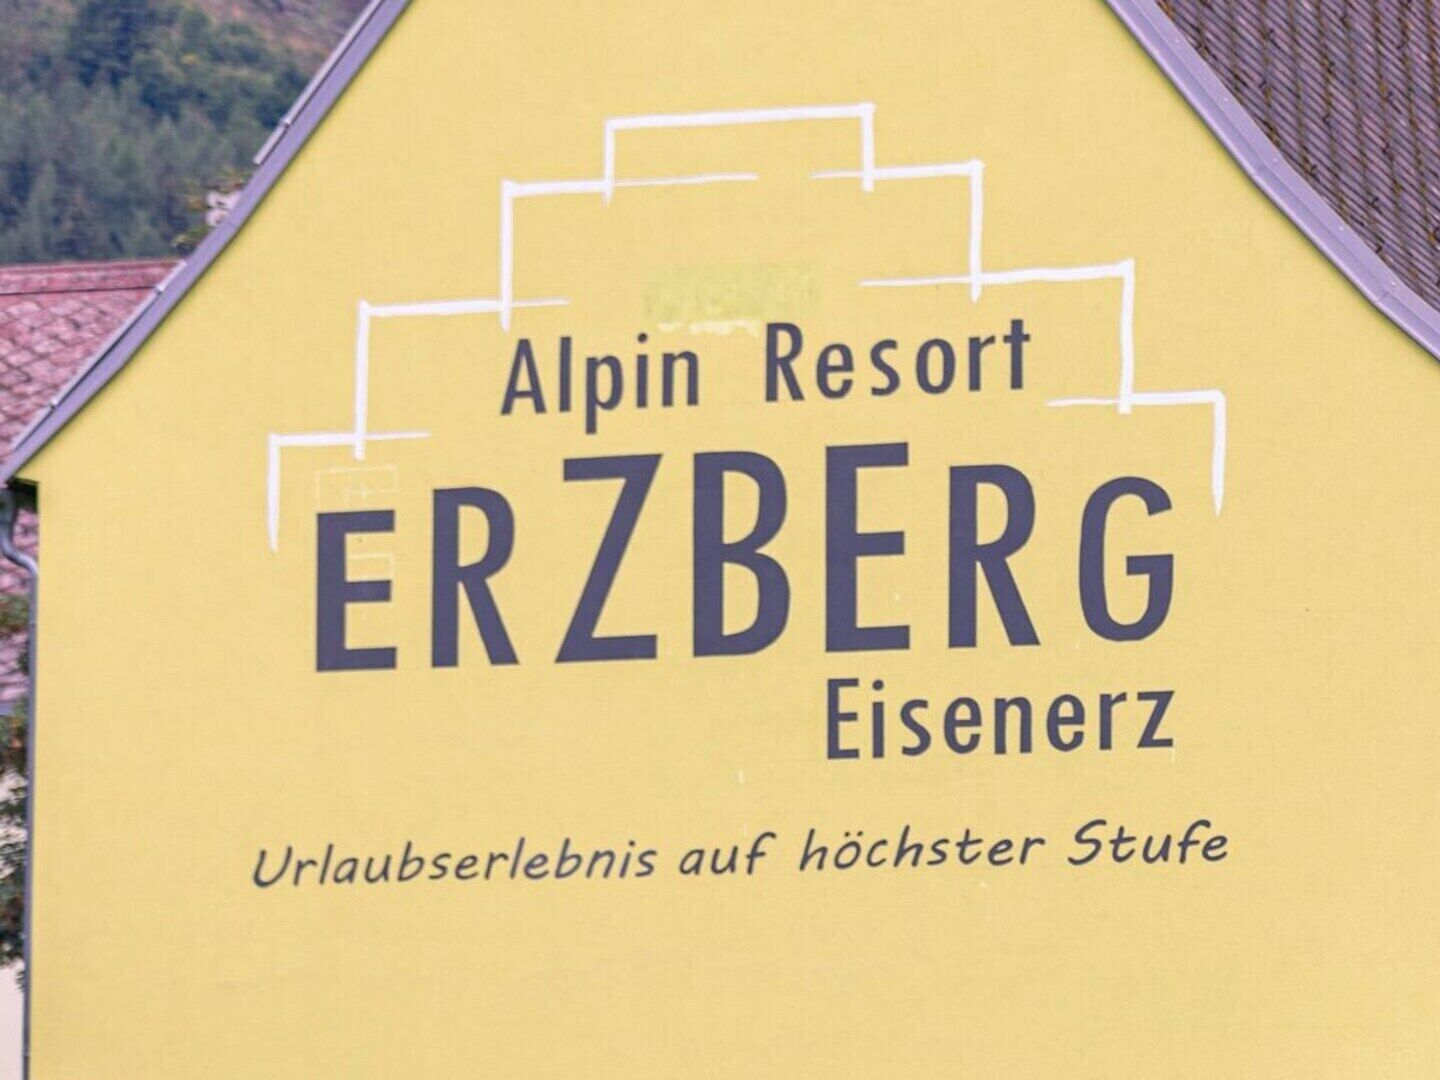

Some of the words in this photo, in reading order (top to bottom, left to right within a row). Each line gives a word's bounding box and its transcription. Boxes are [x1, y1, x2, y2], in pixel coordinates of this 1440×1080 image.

[500, 332, 699, 435] Alpin
[765, 318, 1031, 403] Resort
[315, 442, 1175, 673] ERZBERG
[826, 677, 1175, 761] Eisenerz
[252, 837, 657, 889] Urlaubserlebnis
[679, 831, 776, 876] auf
[799, 824, 1046, 872] höchster
[1067, 818, 1229, 866] Stufe
